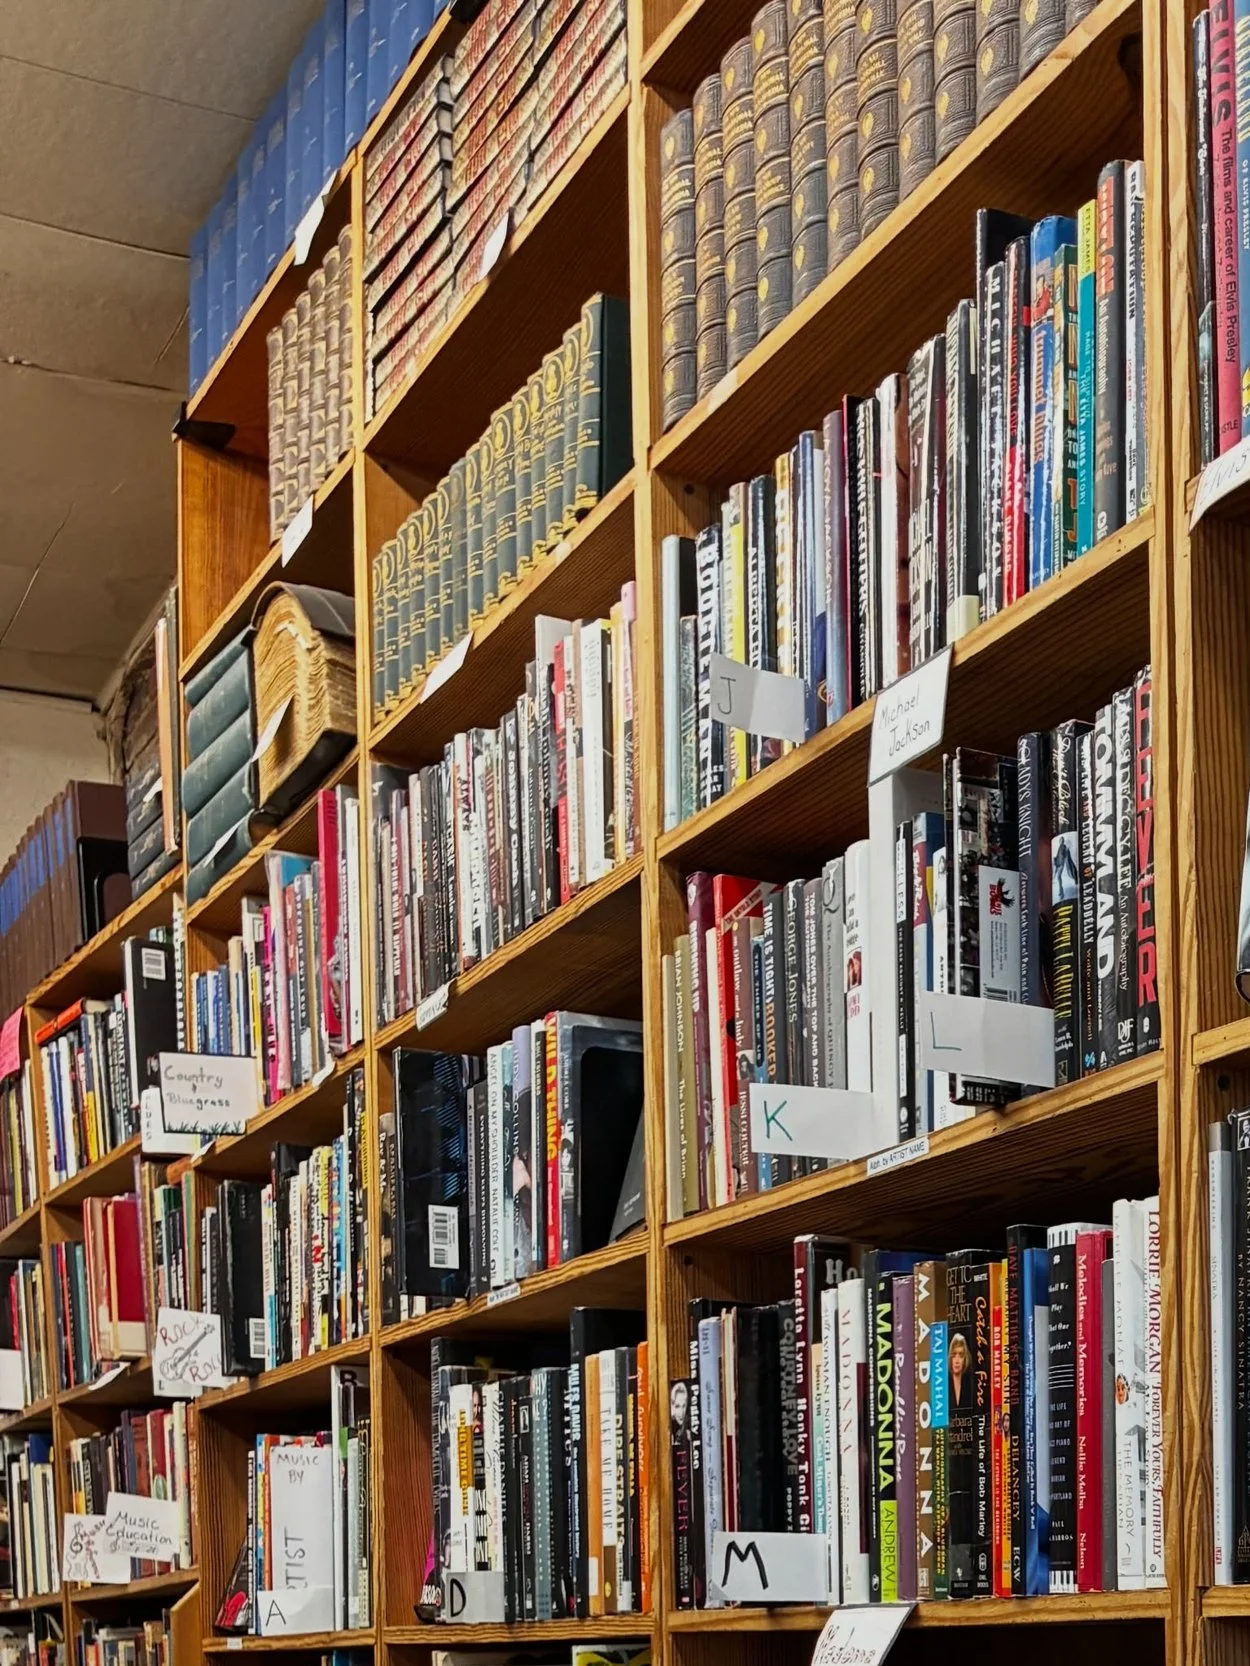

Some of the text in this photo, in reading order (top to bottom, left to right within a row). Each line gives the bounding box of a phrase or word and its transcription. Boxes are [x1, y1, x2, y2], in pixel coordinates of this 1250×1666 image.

[717, 676, 738, 716] J
[876, 692, 919, 727] Michael
[889, 719, 931, 756] Jackson
[1137, 681, 1158, 1006] FEVER
[930, 1011, 962, 1051] L
[164, 1065, 223, 1088] Country
[545, 1016, 558, 1161] WILD THING
[764, 1100, 792, 1141] K
[842, 1309, 852, 1453] MADONNA
[934, 1327, 943, 1418] TAJ MAHAL
[917, 1273, 933, 1557] MADONNA
[278, 1453, 320, 1467] MUSIC
[876, 1303, 896, 1585] MADONNA ANDREW
[289, 1468, 304, 1484] BY
[1011, 1435, 1020, 1519] DELANCEY
[105, 1527, 173, 1546] Education
[114, 1511, 160, 1530] Music
[722, 1541, 768, 1590] M
[265, 1599, 287, 1626] A
[449, 1579, 466, 1616] D
